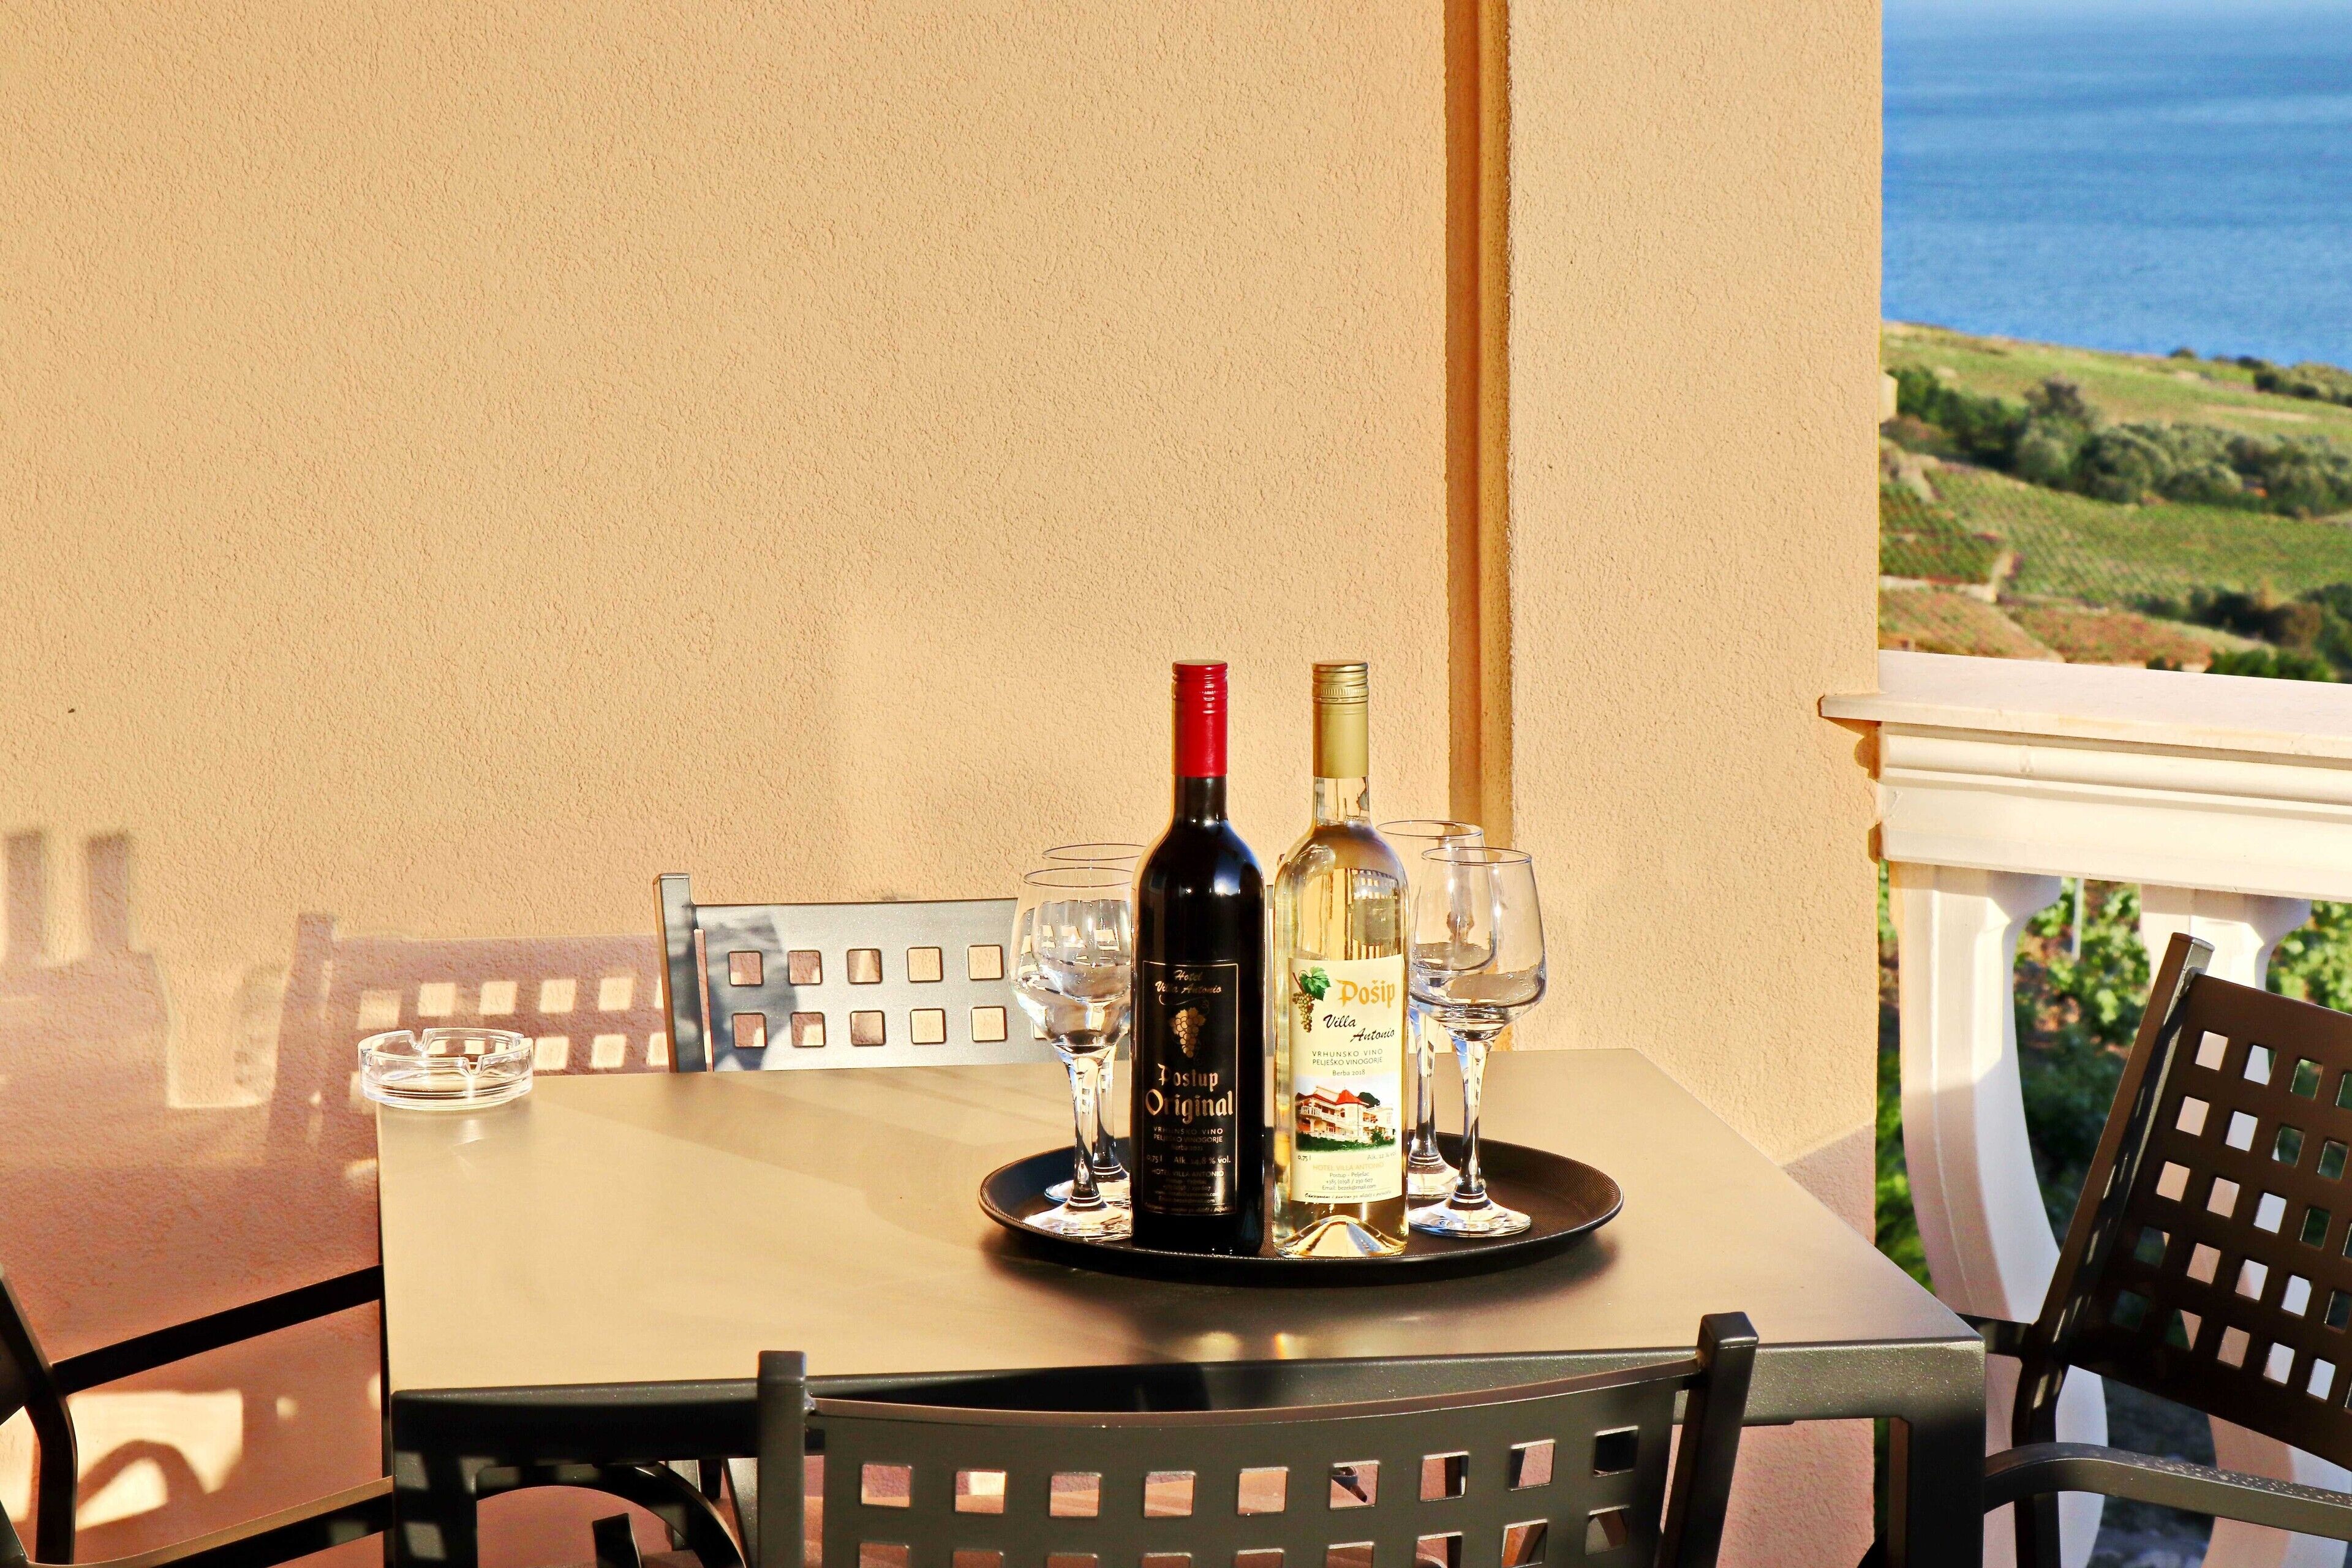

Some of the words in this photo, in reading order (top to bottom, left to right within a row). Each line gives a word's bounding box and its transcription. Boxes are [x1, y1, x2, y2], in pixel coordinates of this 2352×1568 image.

[1175, 970, 1203, 981] Hotel
[1335, 979, 1395, 1008] Pošip
[1323, 1014, 1357, 1028] Villa
[1350, 1028, 1395, 1042] Antonio
[1346, 1057, 1382, 1066] VINOGORJE
[1158, 1063, 1218, 1091] Postup
[1145, 1089, 1234, 1125] Original
[1217, 1155, 1231, 1164] vol.
